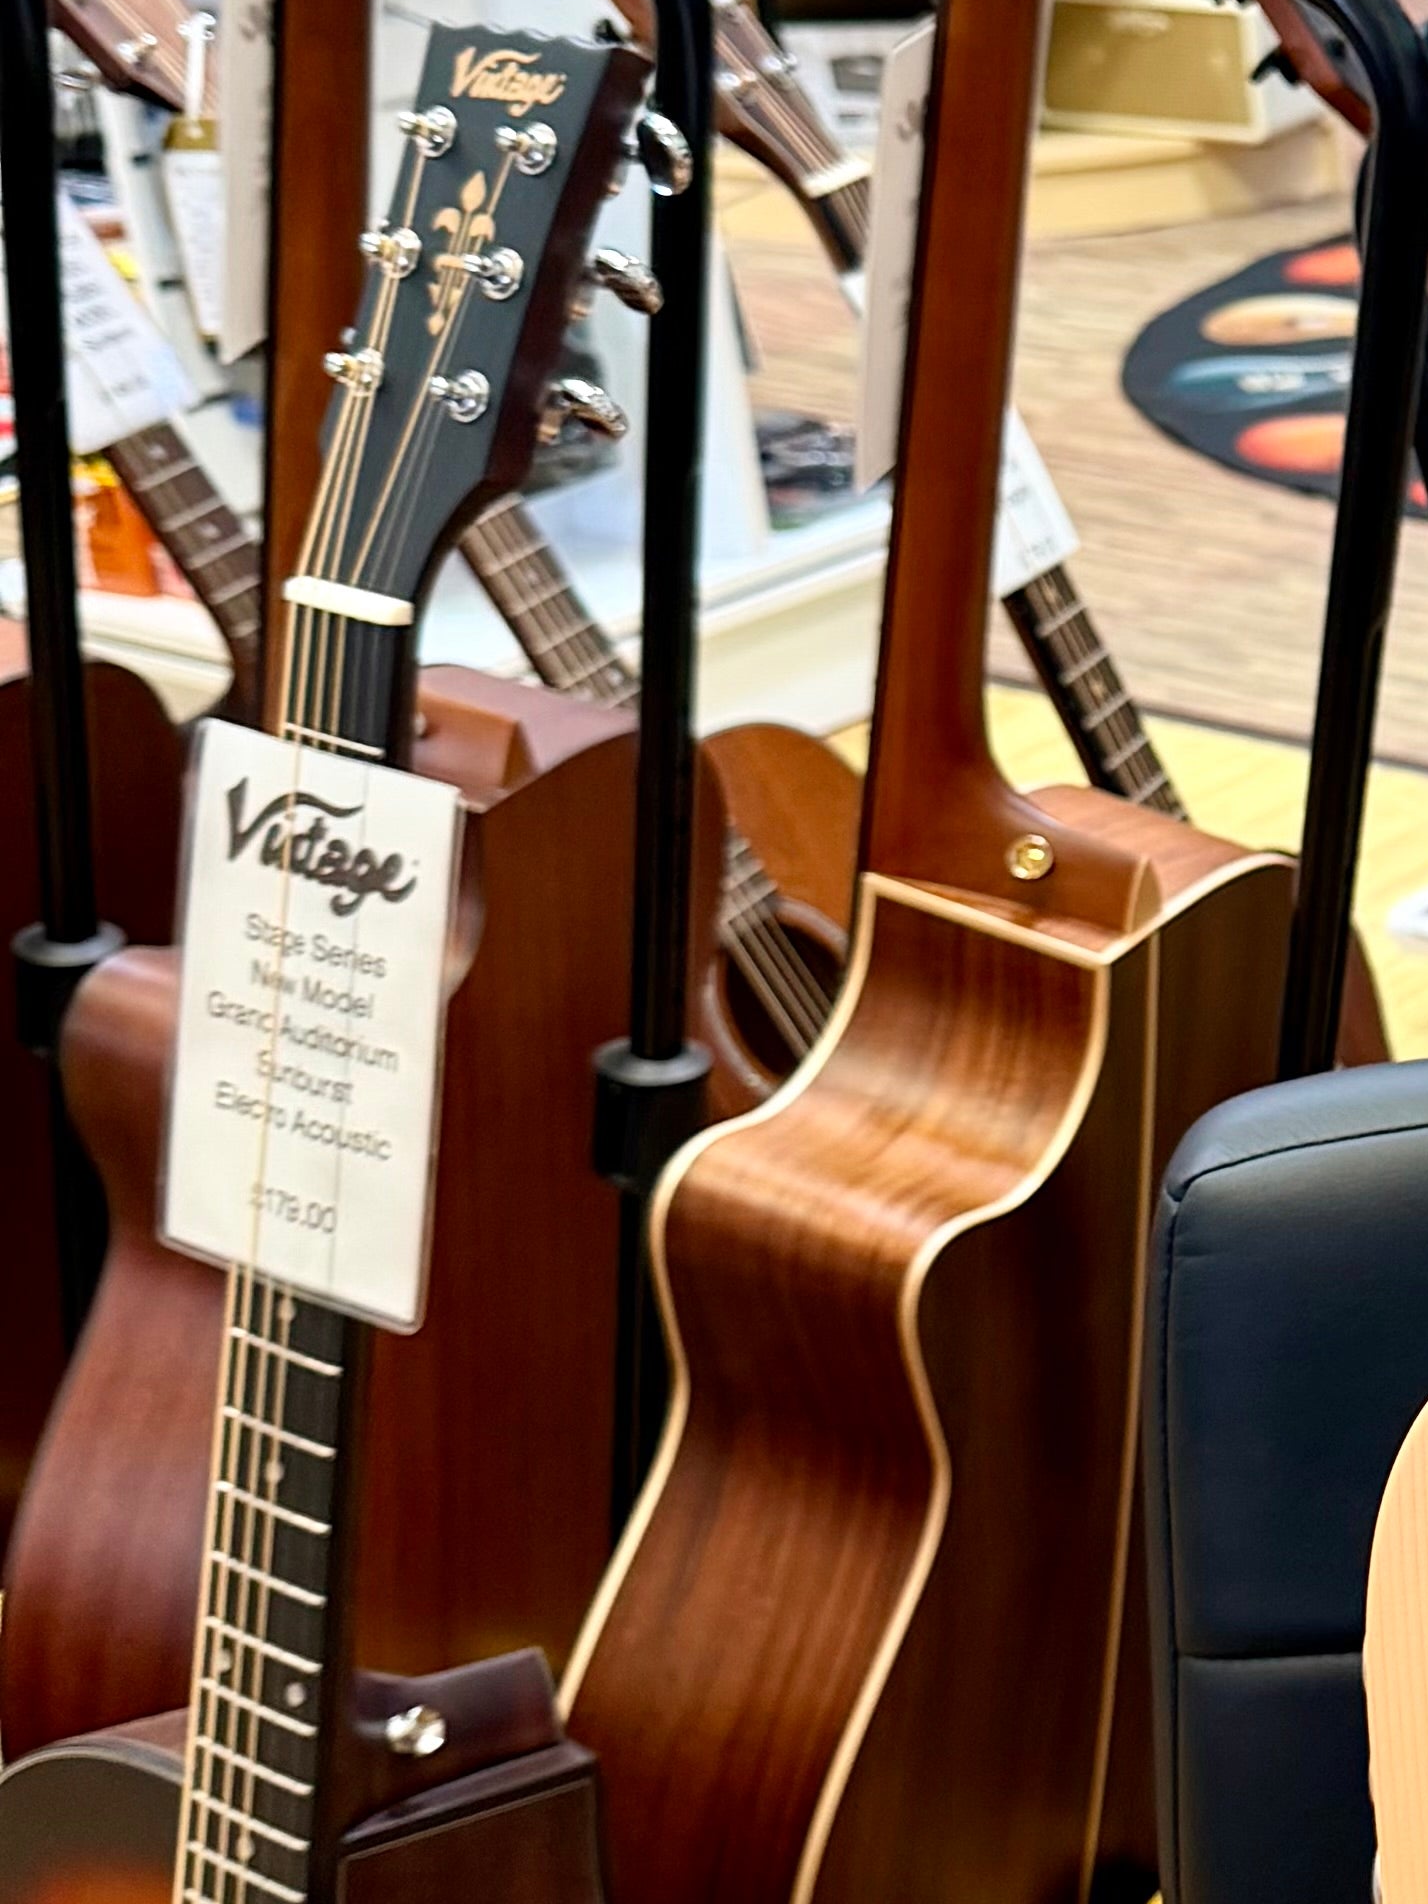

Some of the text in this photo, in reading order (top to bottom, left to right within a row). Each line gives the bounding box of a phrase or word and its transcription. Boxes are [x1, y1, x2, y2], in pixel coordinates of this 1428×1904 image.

[449, 46, 568, 118] Vintage
[226, 775, 420, 917] Vintage
[244, 912, 389, 979] Stage Series
[250, 958, 375, 1019] New Model
[279, 1014, 400, 1073] Auditorium
[290, 1109, 393, 1161] Acoustic
